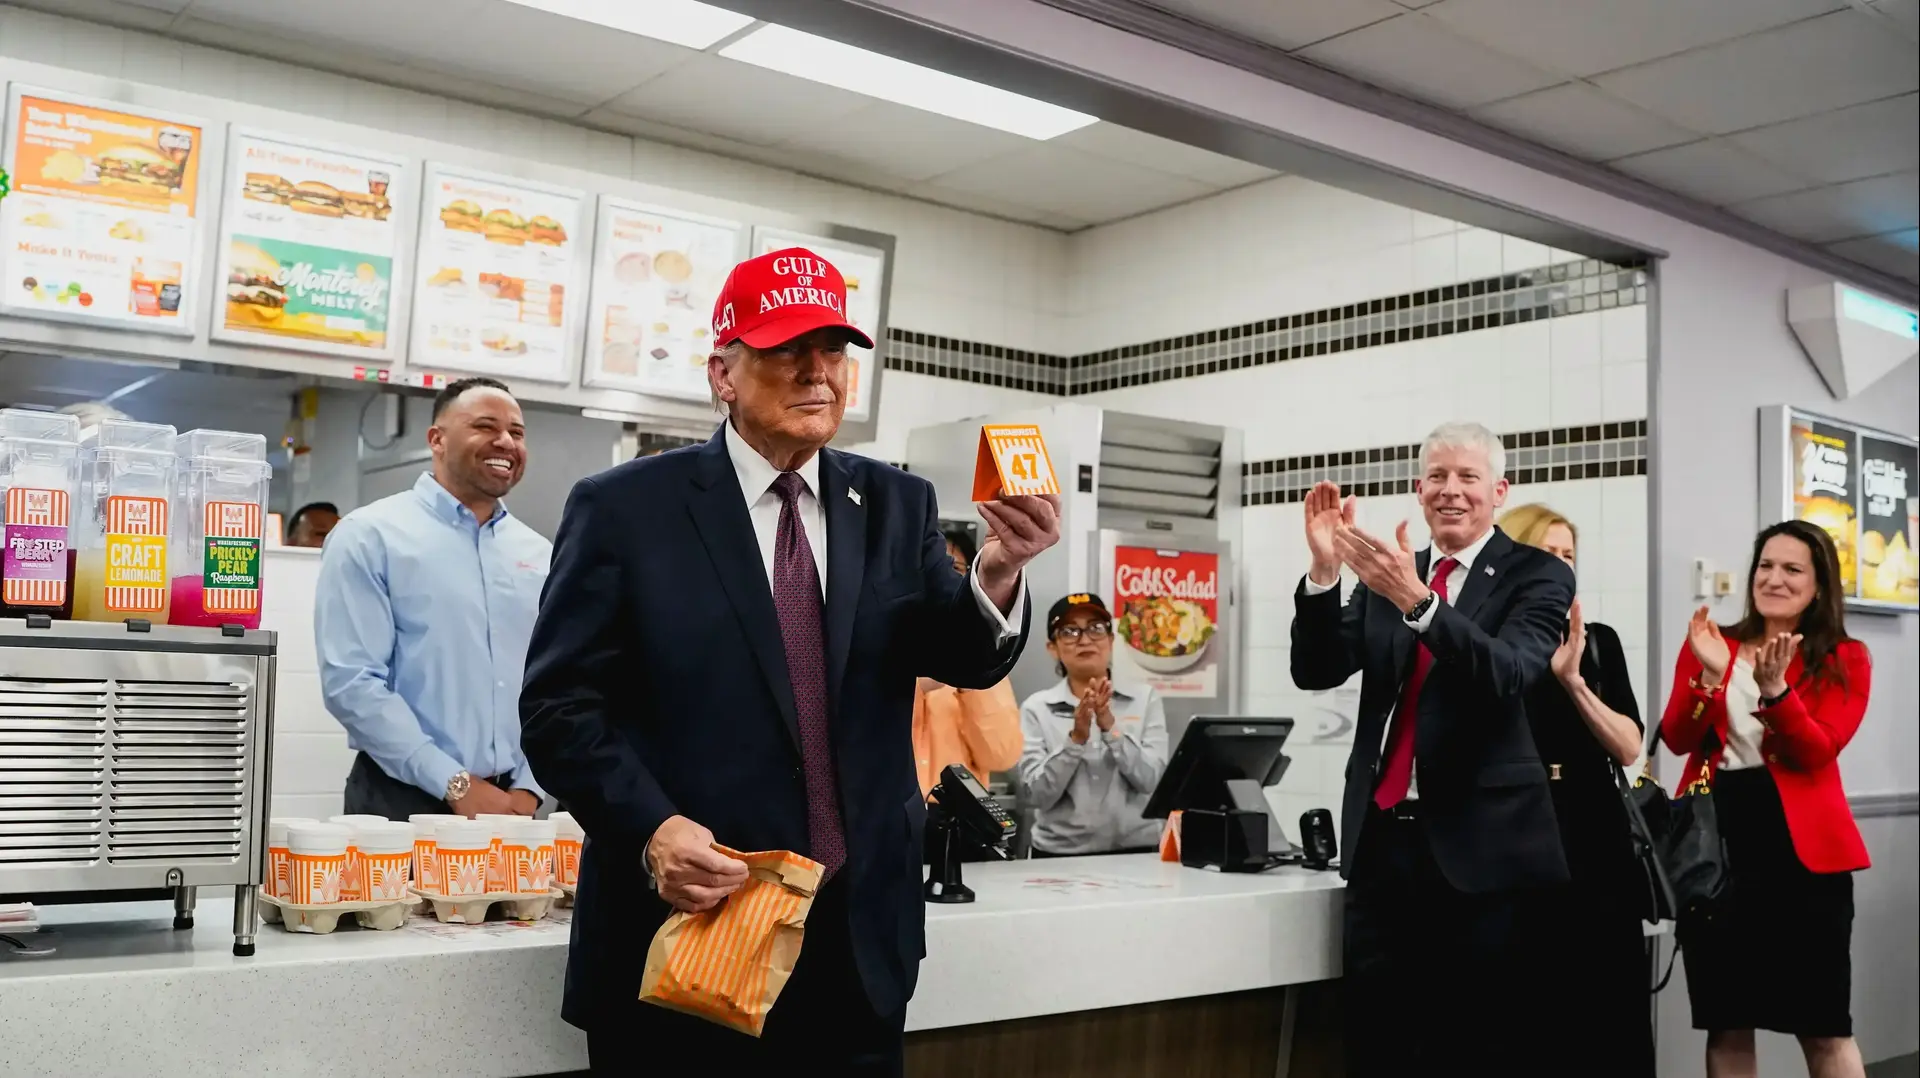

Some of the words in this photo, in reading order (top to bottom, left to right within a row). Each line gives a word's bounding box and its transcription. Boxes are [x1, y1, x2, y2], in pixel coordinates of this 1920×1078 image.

[16, 240, 58, 256] Make
[773, 256, 826, 278] GULF
[275, 261, 387, 313] Monterey
[797, 276, 812, 286] OF
[311, 293, 356, 310] MELT
[759, 287, 844, 318] AMERICA
[1012, 453, 1038, 480] 47
[15, 548, 58, 561] BERRY
[110, 543, 163, 568] CRAFT
[209, 546, 257, 561] PRICKLY
[110, 567, 163, 583] LEMONADE
[218, 560, 248, 574] PEAR
[210, 571, 255, 585] Raspberry
[1116, 564, 1165, 597] Cobb
[1163, 568, 1217, 600] Salad
